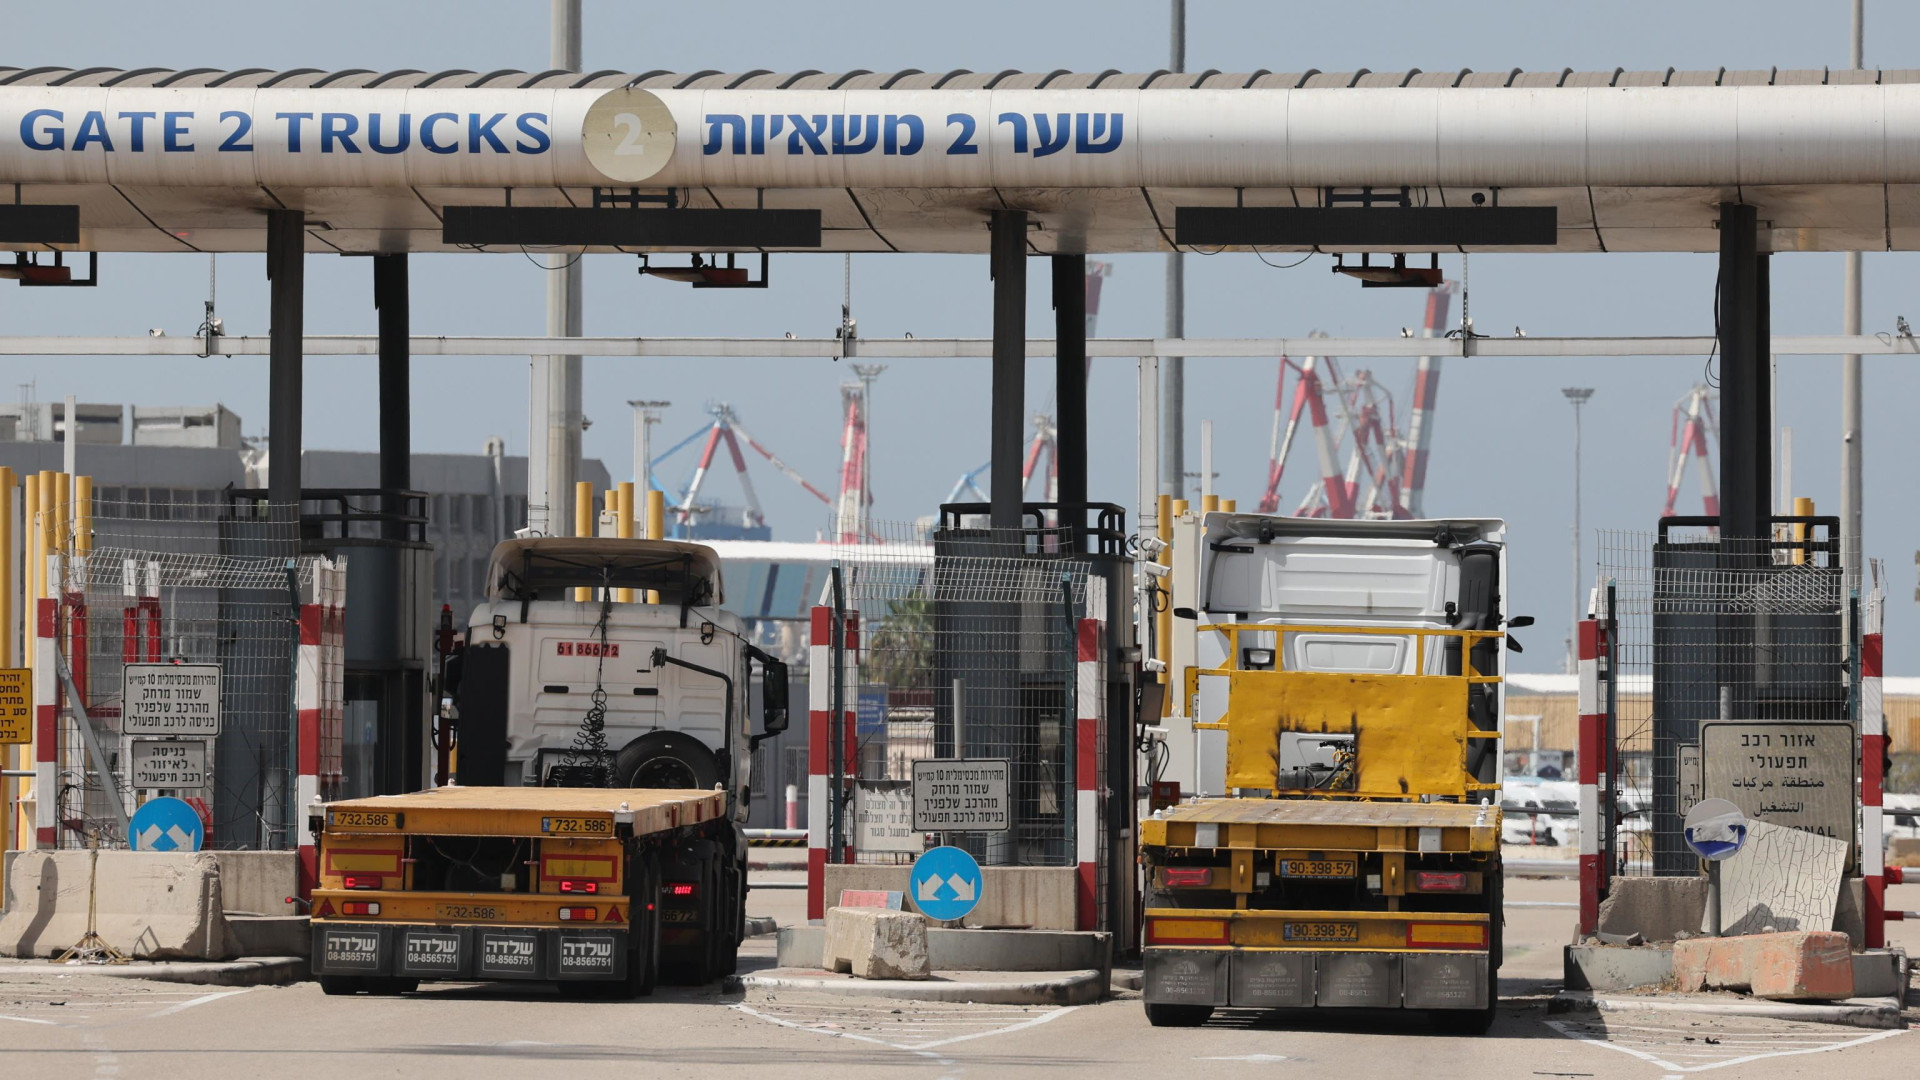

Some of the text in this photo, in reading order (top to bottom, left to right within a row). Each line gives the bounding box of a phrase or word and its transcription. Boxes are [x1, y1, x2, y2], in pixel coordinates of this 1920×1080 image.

[19, 109, 551, 154] GATE 2 TRUCKS
[613, 112, 644, 156] 2
[703, 112, 1124, 158] שער 2 משאיות
[557, 642, 572, 655] 61
[148, 673, 155, 685] 10
[142, 688, 201, 700] שמור מרחק
[135, 701, 209, 714] מהרכב שלפניך
[128, 714, 215, 727] כניסה לרכב תפעולי
[1741, 734, 1815, 747] אזור רכב
[153, 747, 186, 757] כניסה
[150, 758, 188, 769] לאיזור
[1749, 754, 1807, 769] תפעולי
[182, 772, 201, 782] רכב
[936, 769, 944, 781] 10
[931, 784, 989, 796] שמור מרחק
[1732, 776, 1825, 792] منطقة مركبات
[924, 797, 998, 811] מהרכב שלפניך
[1753, 801, 1804, 818] التشغيل
[919, 810, 1004, 823] כניסה לרכב תפעולי
[328, 936, 377, 951] שלדה
[408, 938, 457, 953] שלדה
[486, 940, 534, 955] שלדה
[563, 942, 611, 956] שלדה
[327, 951, 376, 962] 08-8565751
[408, 953, 457, 964] 08-8565751
[485, 954, 534, 965] 08-8565751
[562, 957, 611, 967] 08-8565751
